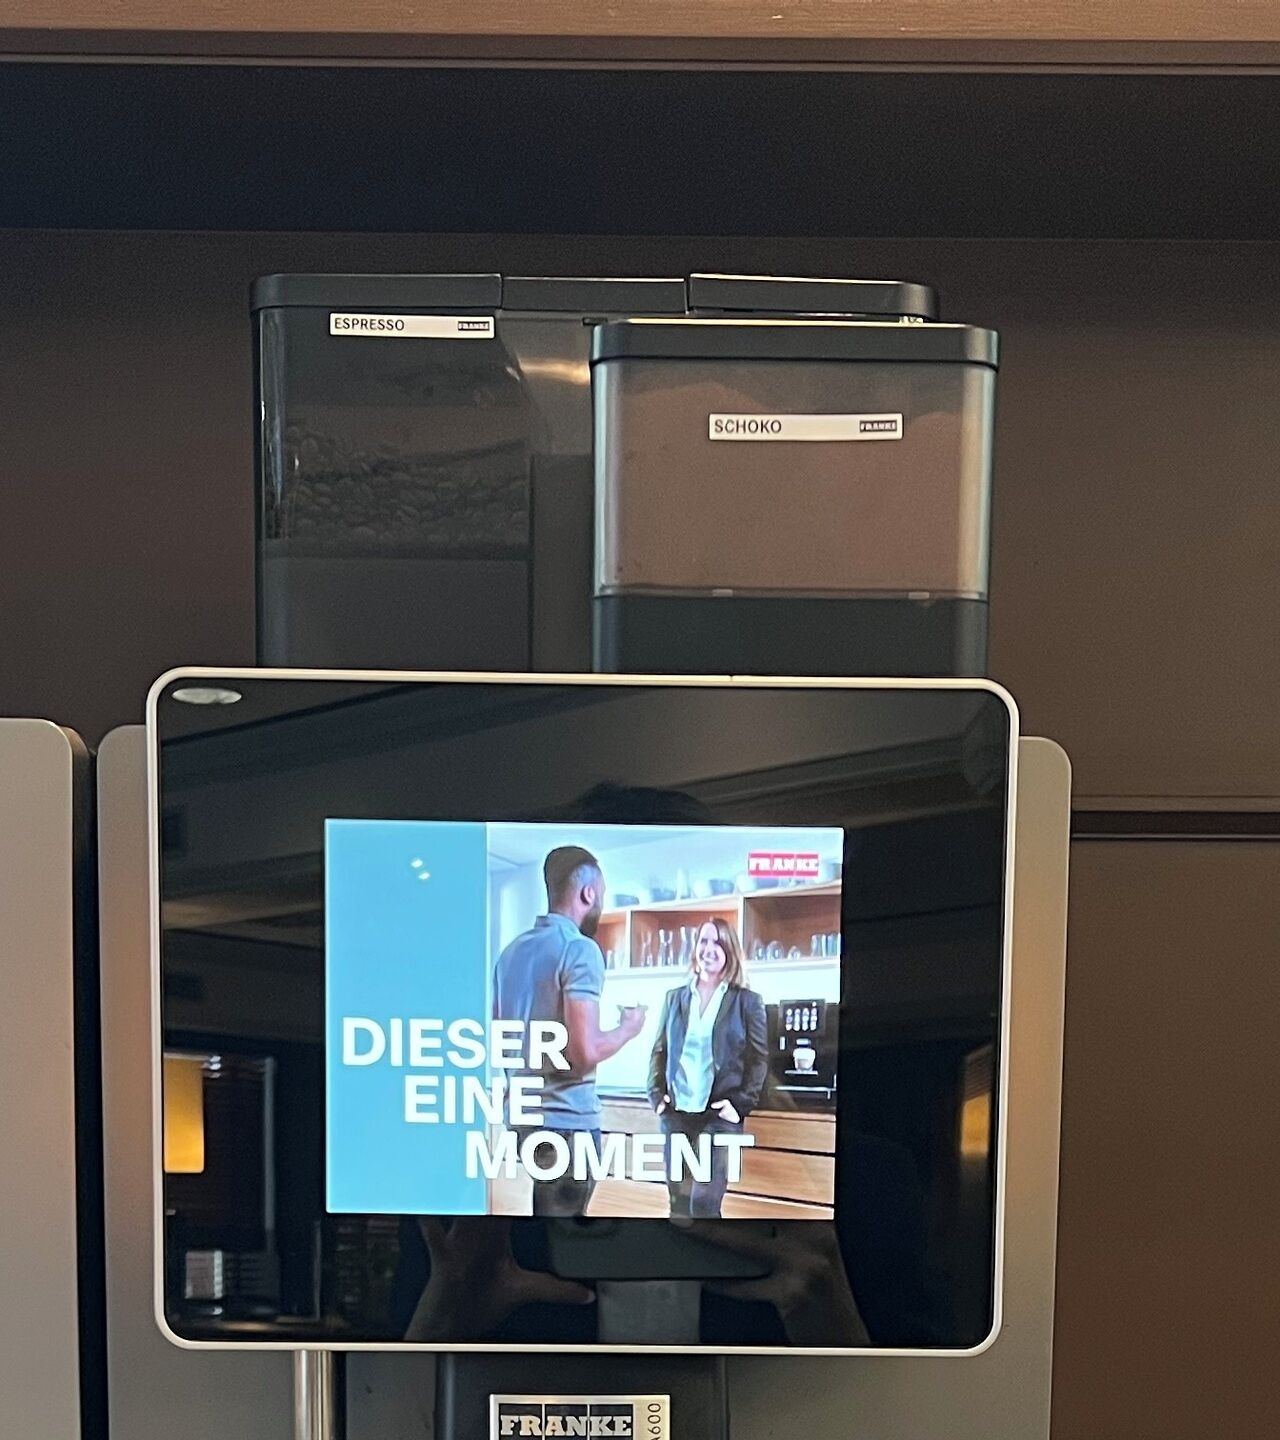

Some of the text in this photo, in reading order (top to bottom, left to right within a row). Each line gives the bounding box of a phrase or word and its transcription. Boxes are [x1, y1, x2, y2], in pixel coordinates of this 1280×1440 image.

[334, 317, 406, 331] ESPRESSO
[713, 418, 783, 434] SCHOKO
[749, 857, 819, 872] FRANKE
[341, 1016, 571, 1071] DIESER
[404, 1075, 546, 1126] EINE
[465, 1130, 755, 1183] MOMENT
[500, 1414, 632, 1437] FRANKE
